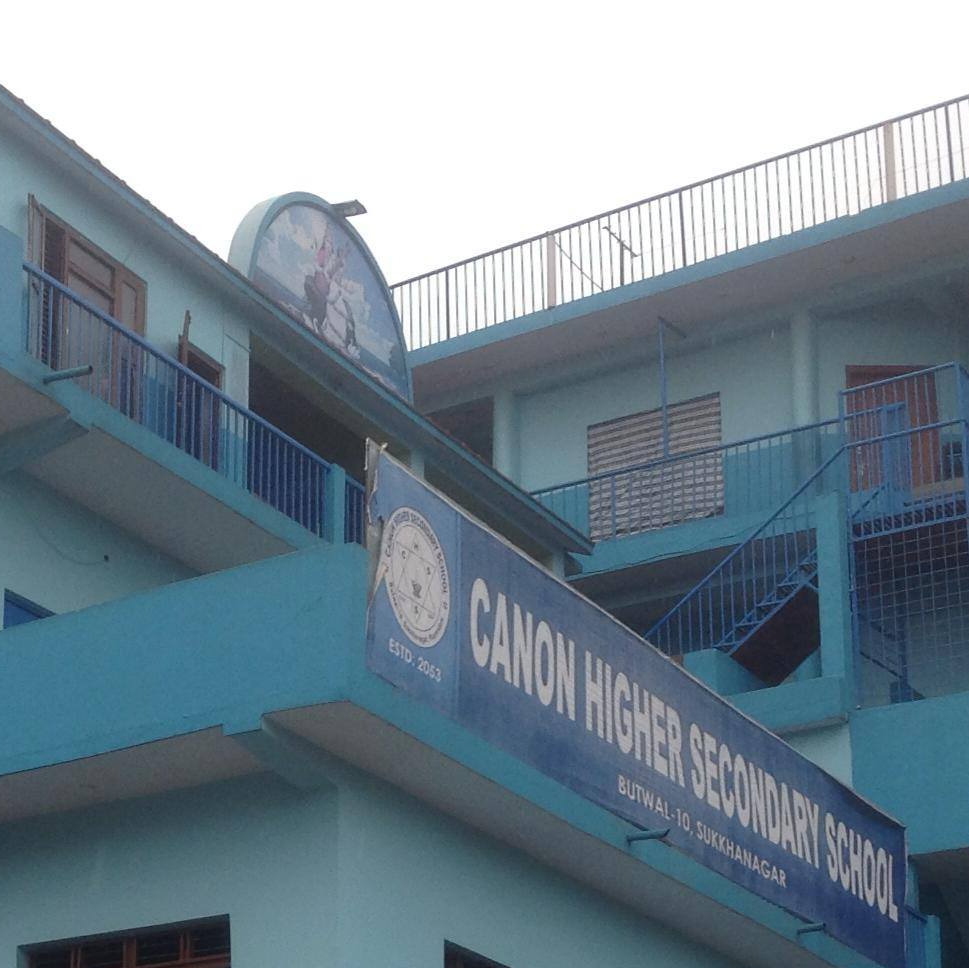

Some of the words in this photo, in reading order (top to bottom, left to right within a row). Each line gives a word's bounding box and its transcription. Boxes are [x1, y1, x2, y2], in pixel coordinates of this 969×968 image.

[389, 637, 416, 667] ESTD:
[417, 656, 443, 683] 2053
[469, 577, 577, 721] CANON
[584, 648, 686, 789] HIGHER
[689, 721, 819, 871] SECONDARY
[824, 812, 900, 923] SCHOOL
[617, 773, 694, 839] BUTWAL-10,
[696, 820, 787, 889] SUKKHANAGAR
